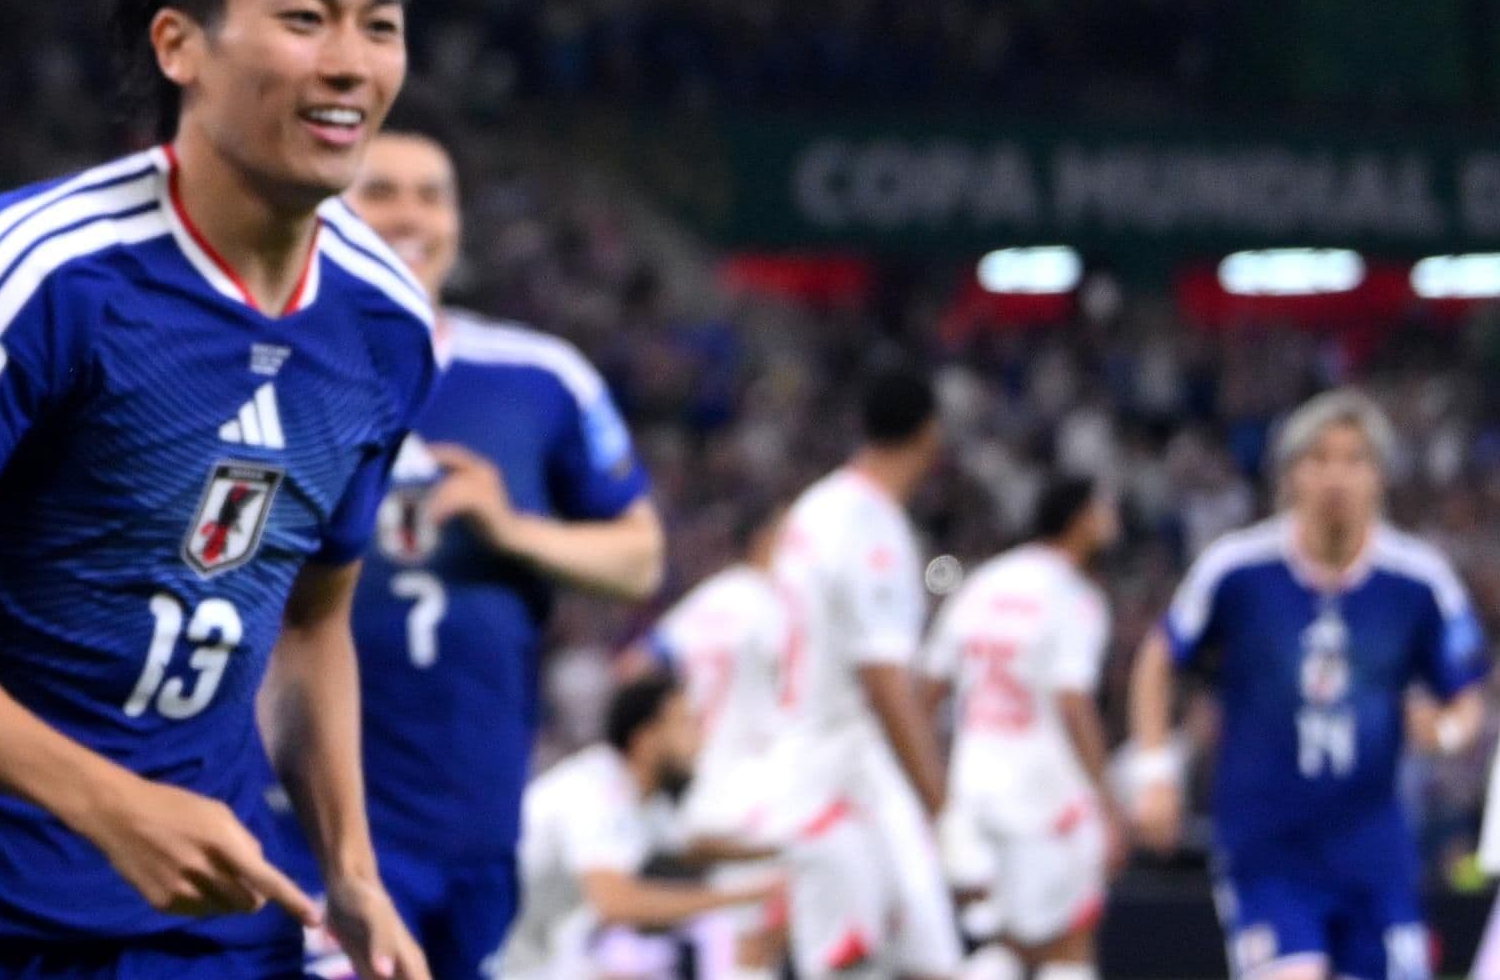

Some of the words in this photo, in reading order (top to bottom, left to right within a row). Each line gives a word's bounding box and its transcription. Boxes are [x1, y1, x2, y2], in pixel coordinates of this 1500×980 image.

[795, 137, 1037, 226] COPA
[123, 593, 243, 719] 13
[389, 571, 448, 667] 7
